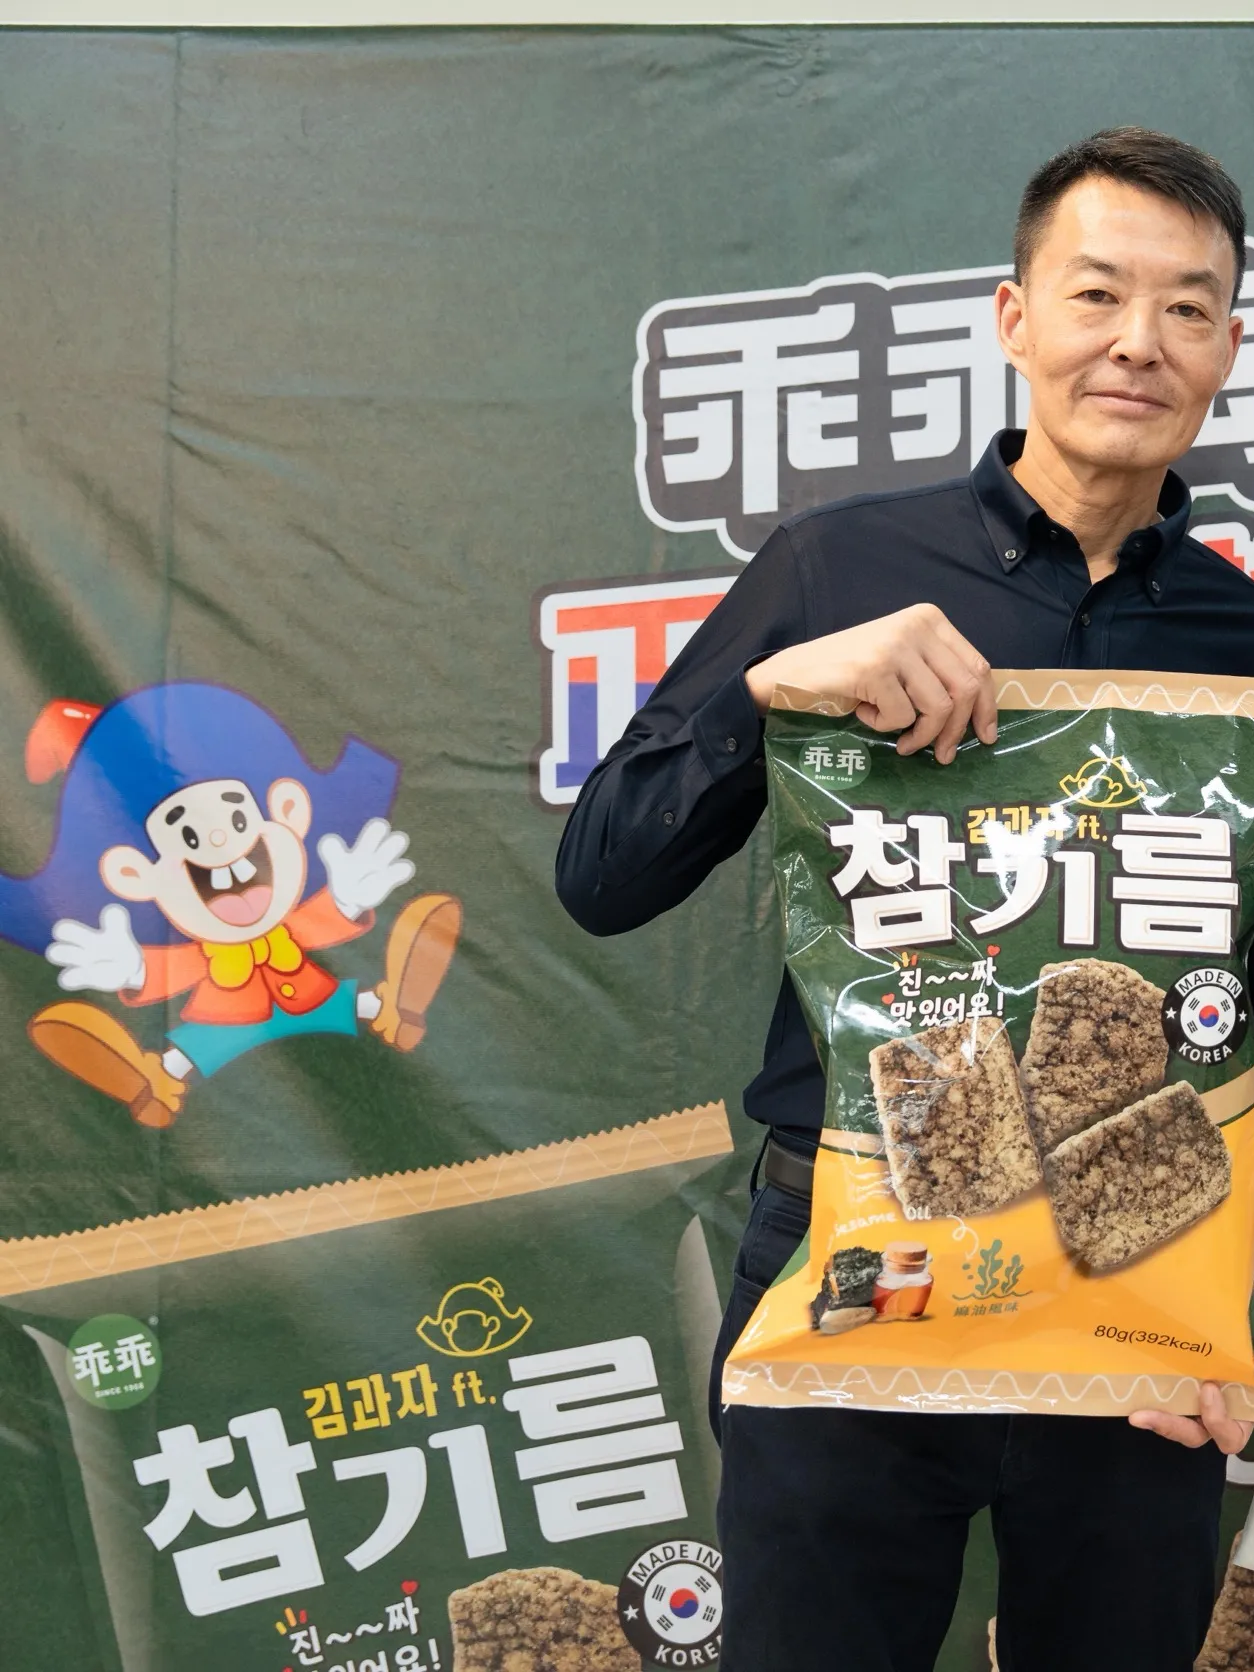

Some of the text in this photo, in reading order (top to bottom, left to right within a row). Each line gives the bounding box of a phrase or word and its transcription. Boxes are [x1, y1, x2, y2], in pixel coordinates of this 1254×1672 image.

[803, 746, 866, 776] 乖乖
[1077, 814, 1108, 842] ft.
[829, 809, 1239, 956] 참기름
[1178, 970, 1242, 996] MADE IN
[890, 991, 1005, 1028] 맛있어요!
[1178, 1041, 1233, 1064] KOREA
[1094, 1324, 1214, 1358] 80g(392kcal)
[72, 1333, 157, 1388] 乖乖
[303, 1363, 498, 1440] 김과자 ft.
[132, 1335, 689, 1617] 참기름
[631, 1543, 720, 1583] MADE IN
